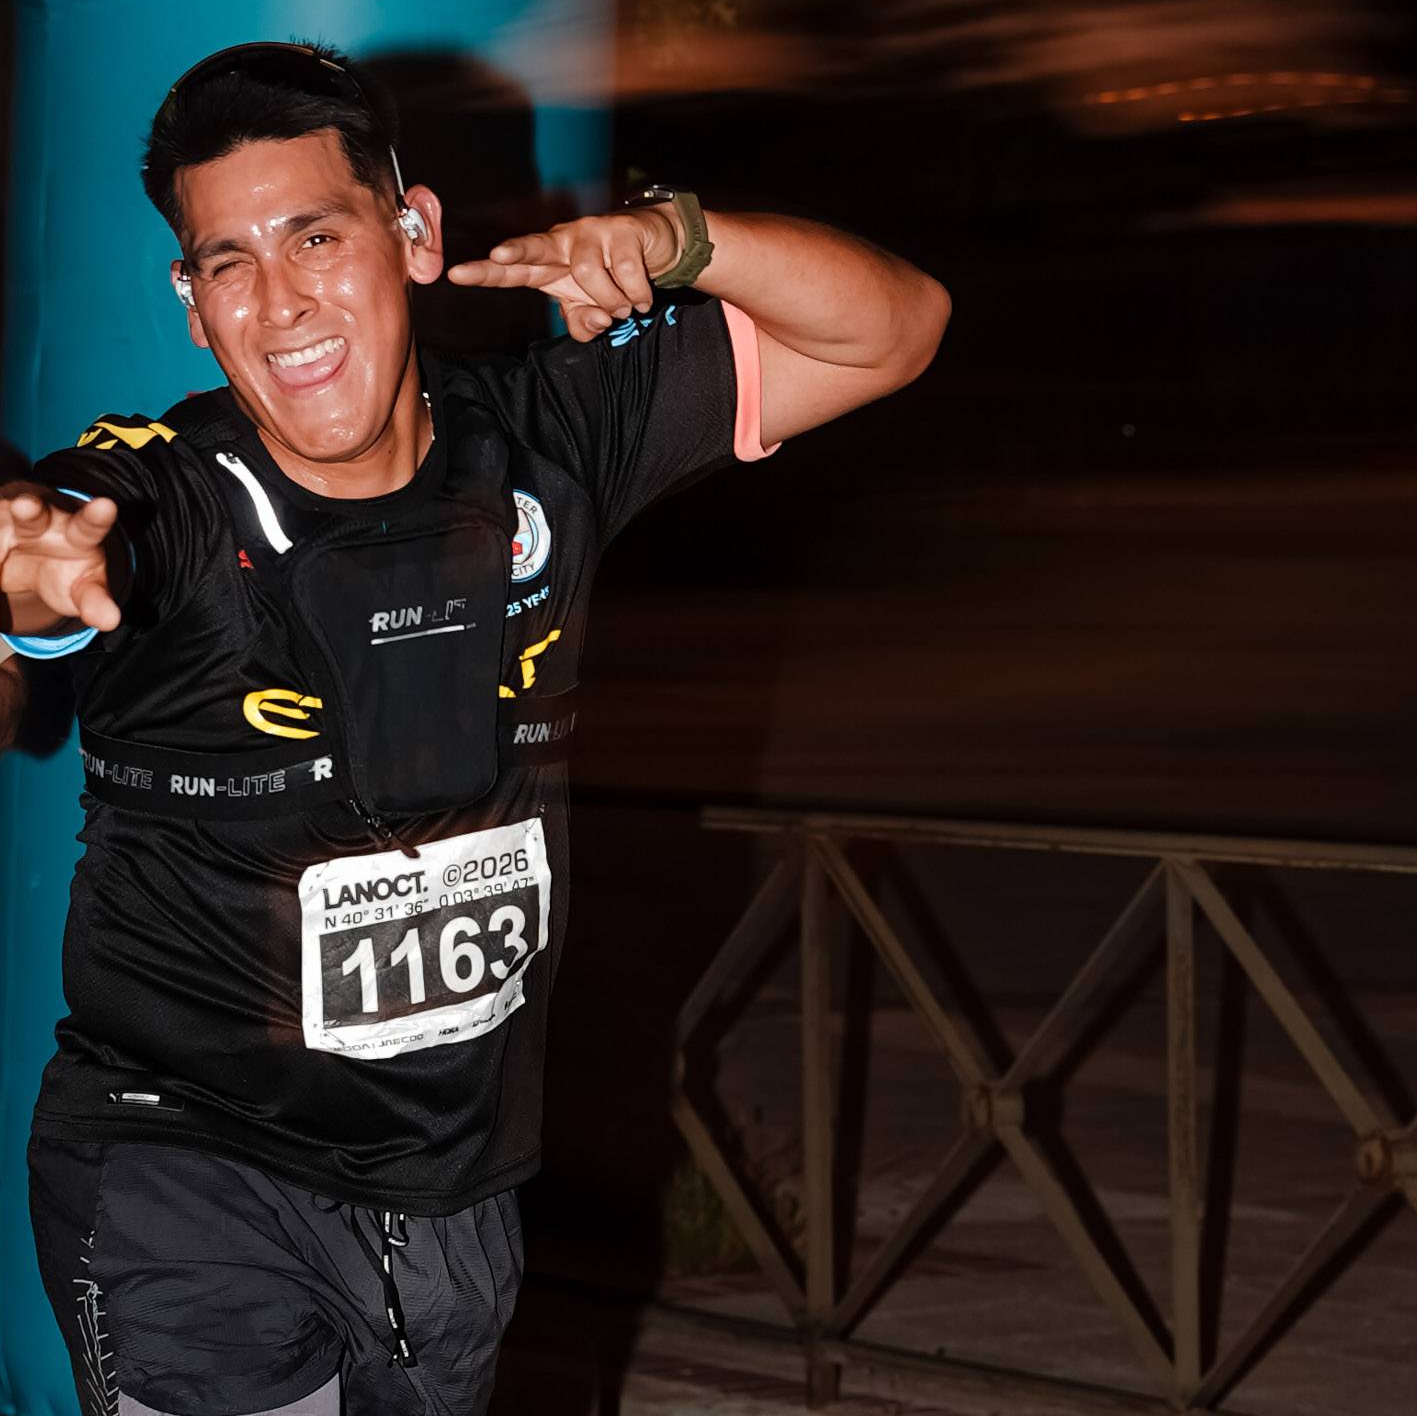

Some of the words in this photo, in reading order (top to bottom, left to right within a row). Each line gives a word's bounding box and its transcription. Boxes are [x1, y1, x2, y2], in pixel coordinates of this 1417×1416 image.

[505, 601, 522, 618] 25
[170, 770, 286, 798] RUN-LITE
[322, 870, 429, 910] LANOCT.
[324, 916, 337, 929] N
[341, 904, 529, 1014] 1163
